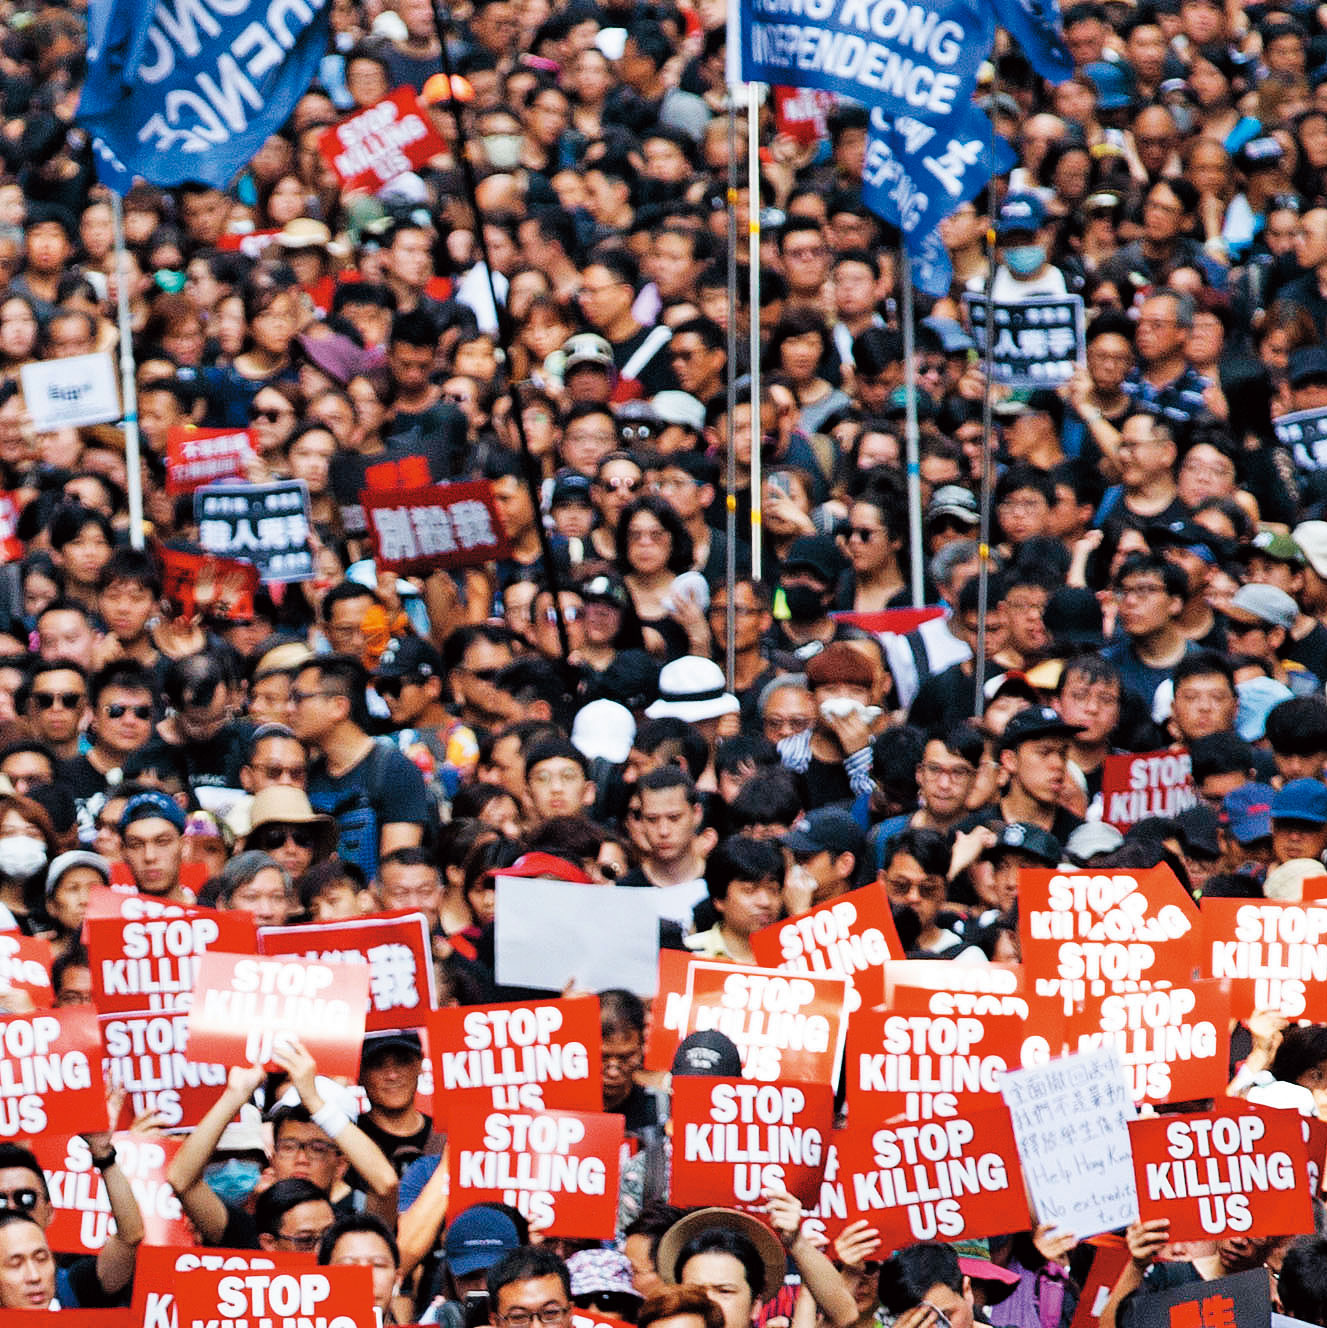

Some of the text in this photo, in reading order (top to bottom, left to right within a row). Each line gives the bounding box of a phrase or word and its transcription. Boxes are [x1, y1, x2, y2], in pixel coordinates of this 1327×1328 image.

[1254, 980, 1308, 1018] US
[710, 1084, 806, 1125] STOP
[684, 1125, 822, 1162] KILLING
[872, 1120, 973, 1170] STOP
[1168, 1116, 1266, 1159] STOP
[734, 1162, 784, 1197] US
[853, 1153, 1008, 1211] KILLING
[1146, 1153, 1295, 1203] KILLING
[908, 1197, 964, 1241] US
[1198, 1194, 1253, 1231] US
[216, 1275, 330, 1319] STOP
